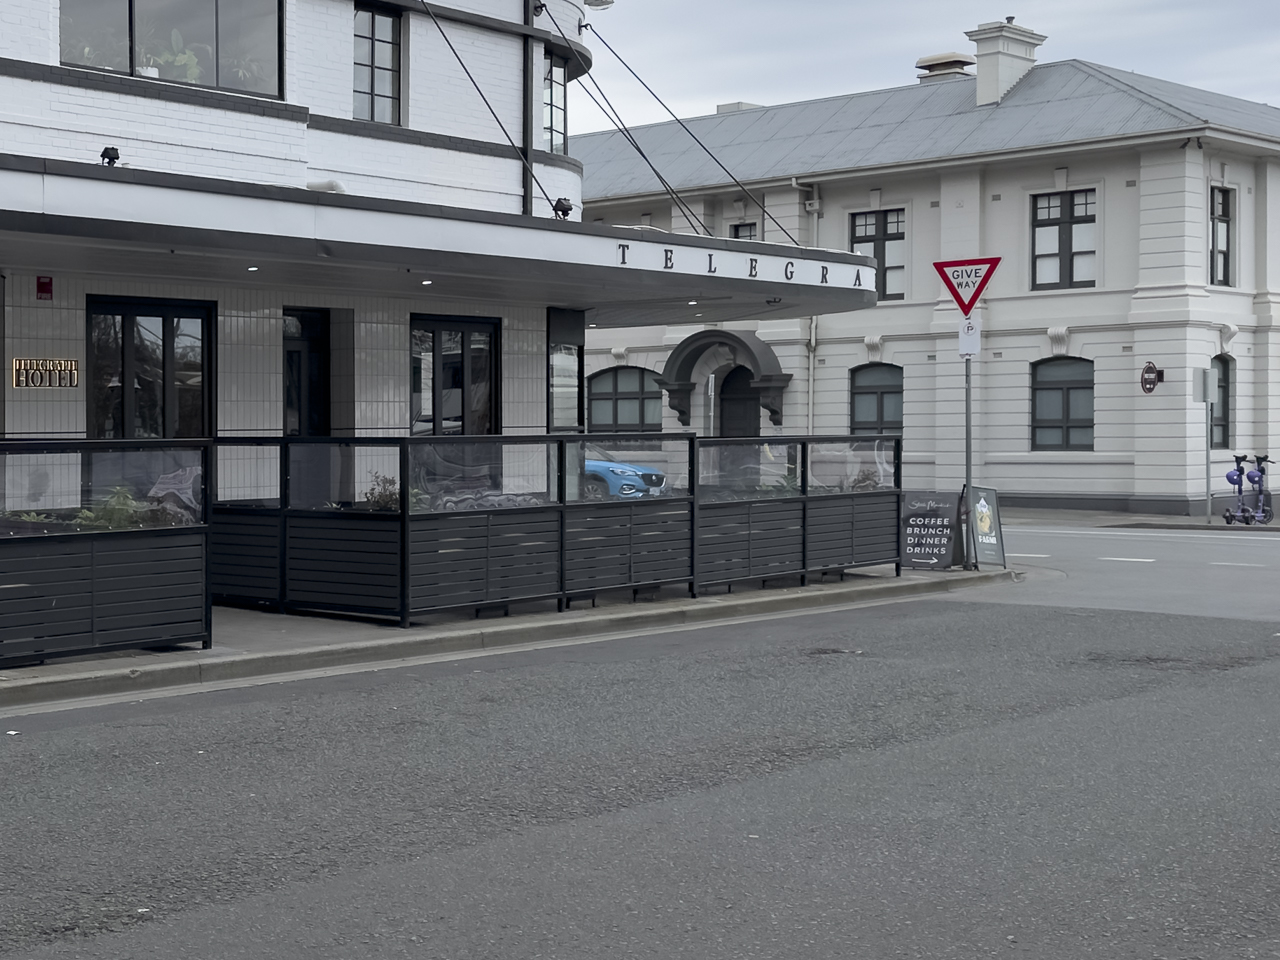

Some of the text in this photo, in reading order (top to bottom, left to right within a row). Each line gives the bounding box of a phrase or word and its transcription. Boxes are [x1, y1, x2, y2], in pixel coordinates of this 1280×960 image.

[952, 268, 982, 279] GIVE
[956, 281, 977, 289] WAY
[14, 370, 78, 387] HOTEL
[906, 546, 946, 555] DRINKS
